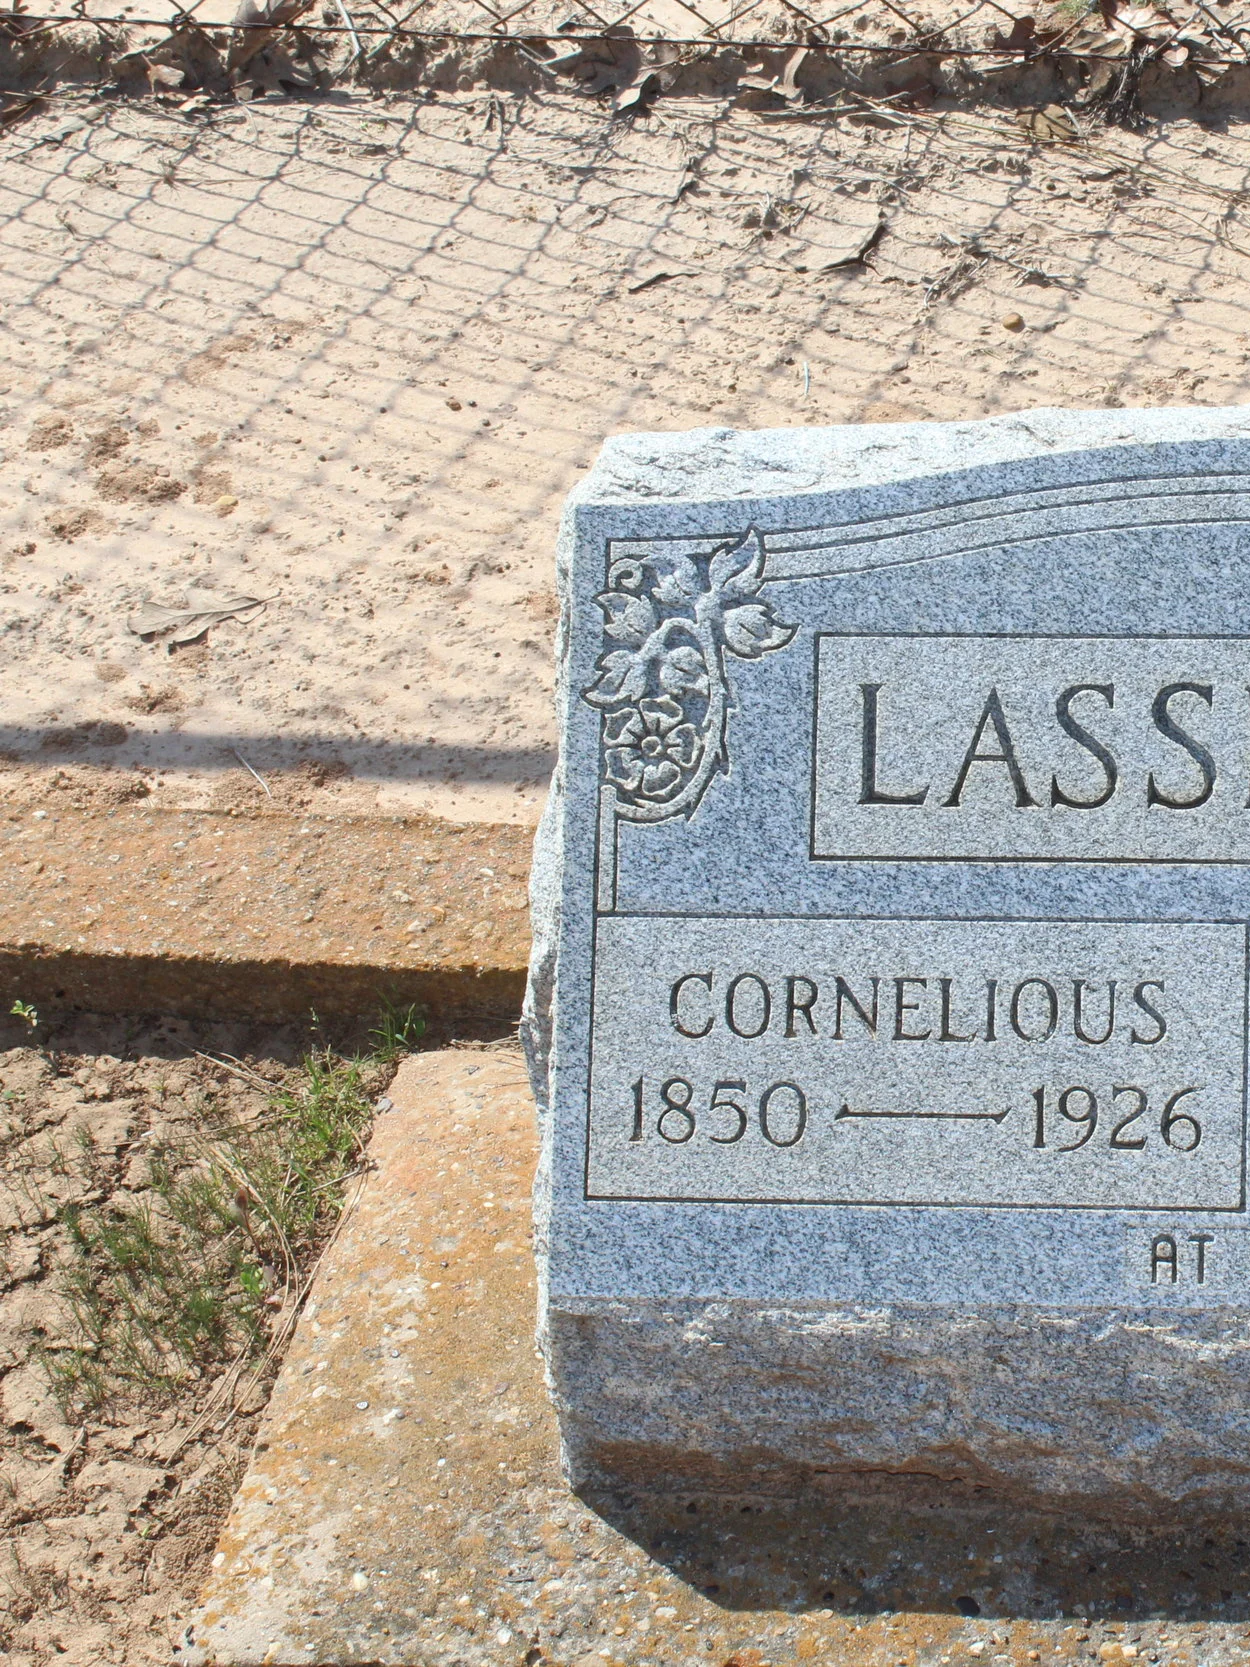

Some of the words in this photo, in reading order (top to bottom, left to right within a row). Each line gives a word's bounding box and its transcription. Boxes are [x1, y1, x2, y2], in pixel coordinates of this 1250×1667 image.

[669, 971, 1167, 1045] CORNELIOUS
[628, 1075, 808, 1147] 1850
[1031, 1085, 1205, 1152] 1926
[1151, 1234, 1214, 1284] AT
